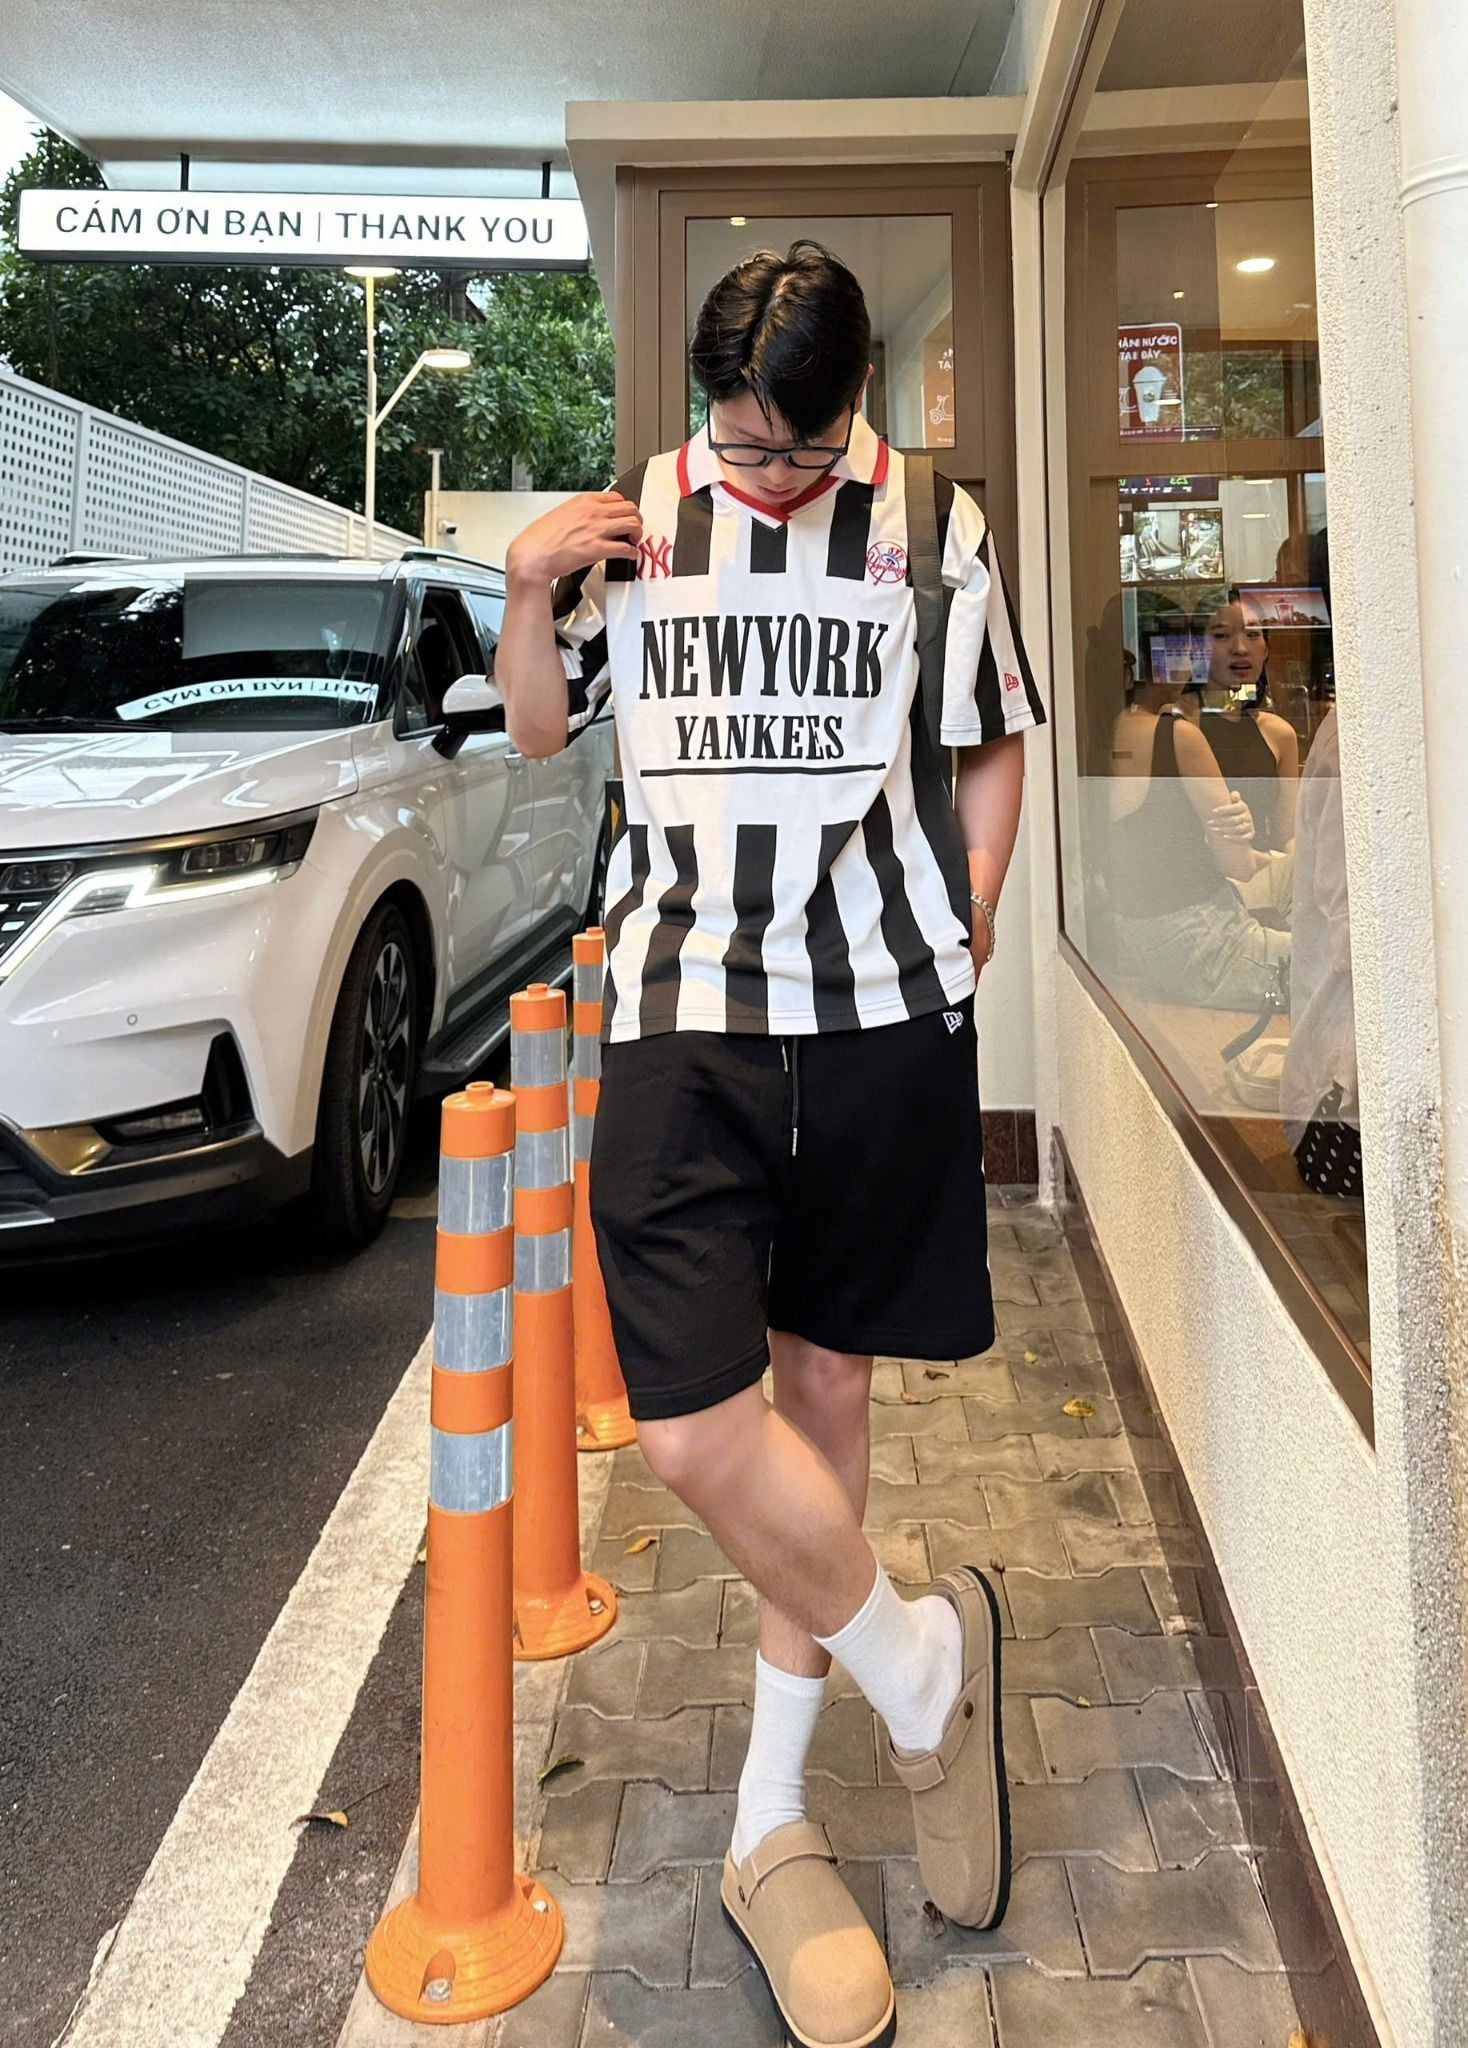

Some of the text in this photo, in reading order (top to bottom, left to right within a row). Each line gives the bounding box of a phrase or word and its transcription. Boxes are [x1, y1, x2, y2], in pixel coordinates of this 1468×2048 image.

[55, 199, 554, 244] CÁM ƠN BẠN THANK YOU
[674, 713, 845, 761] YANKEES
